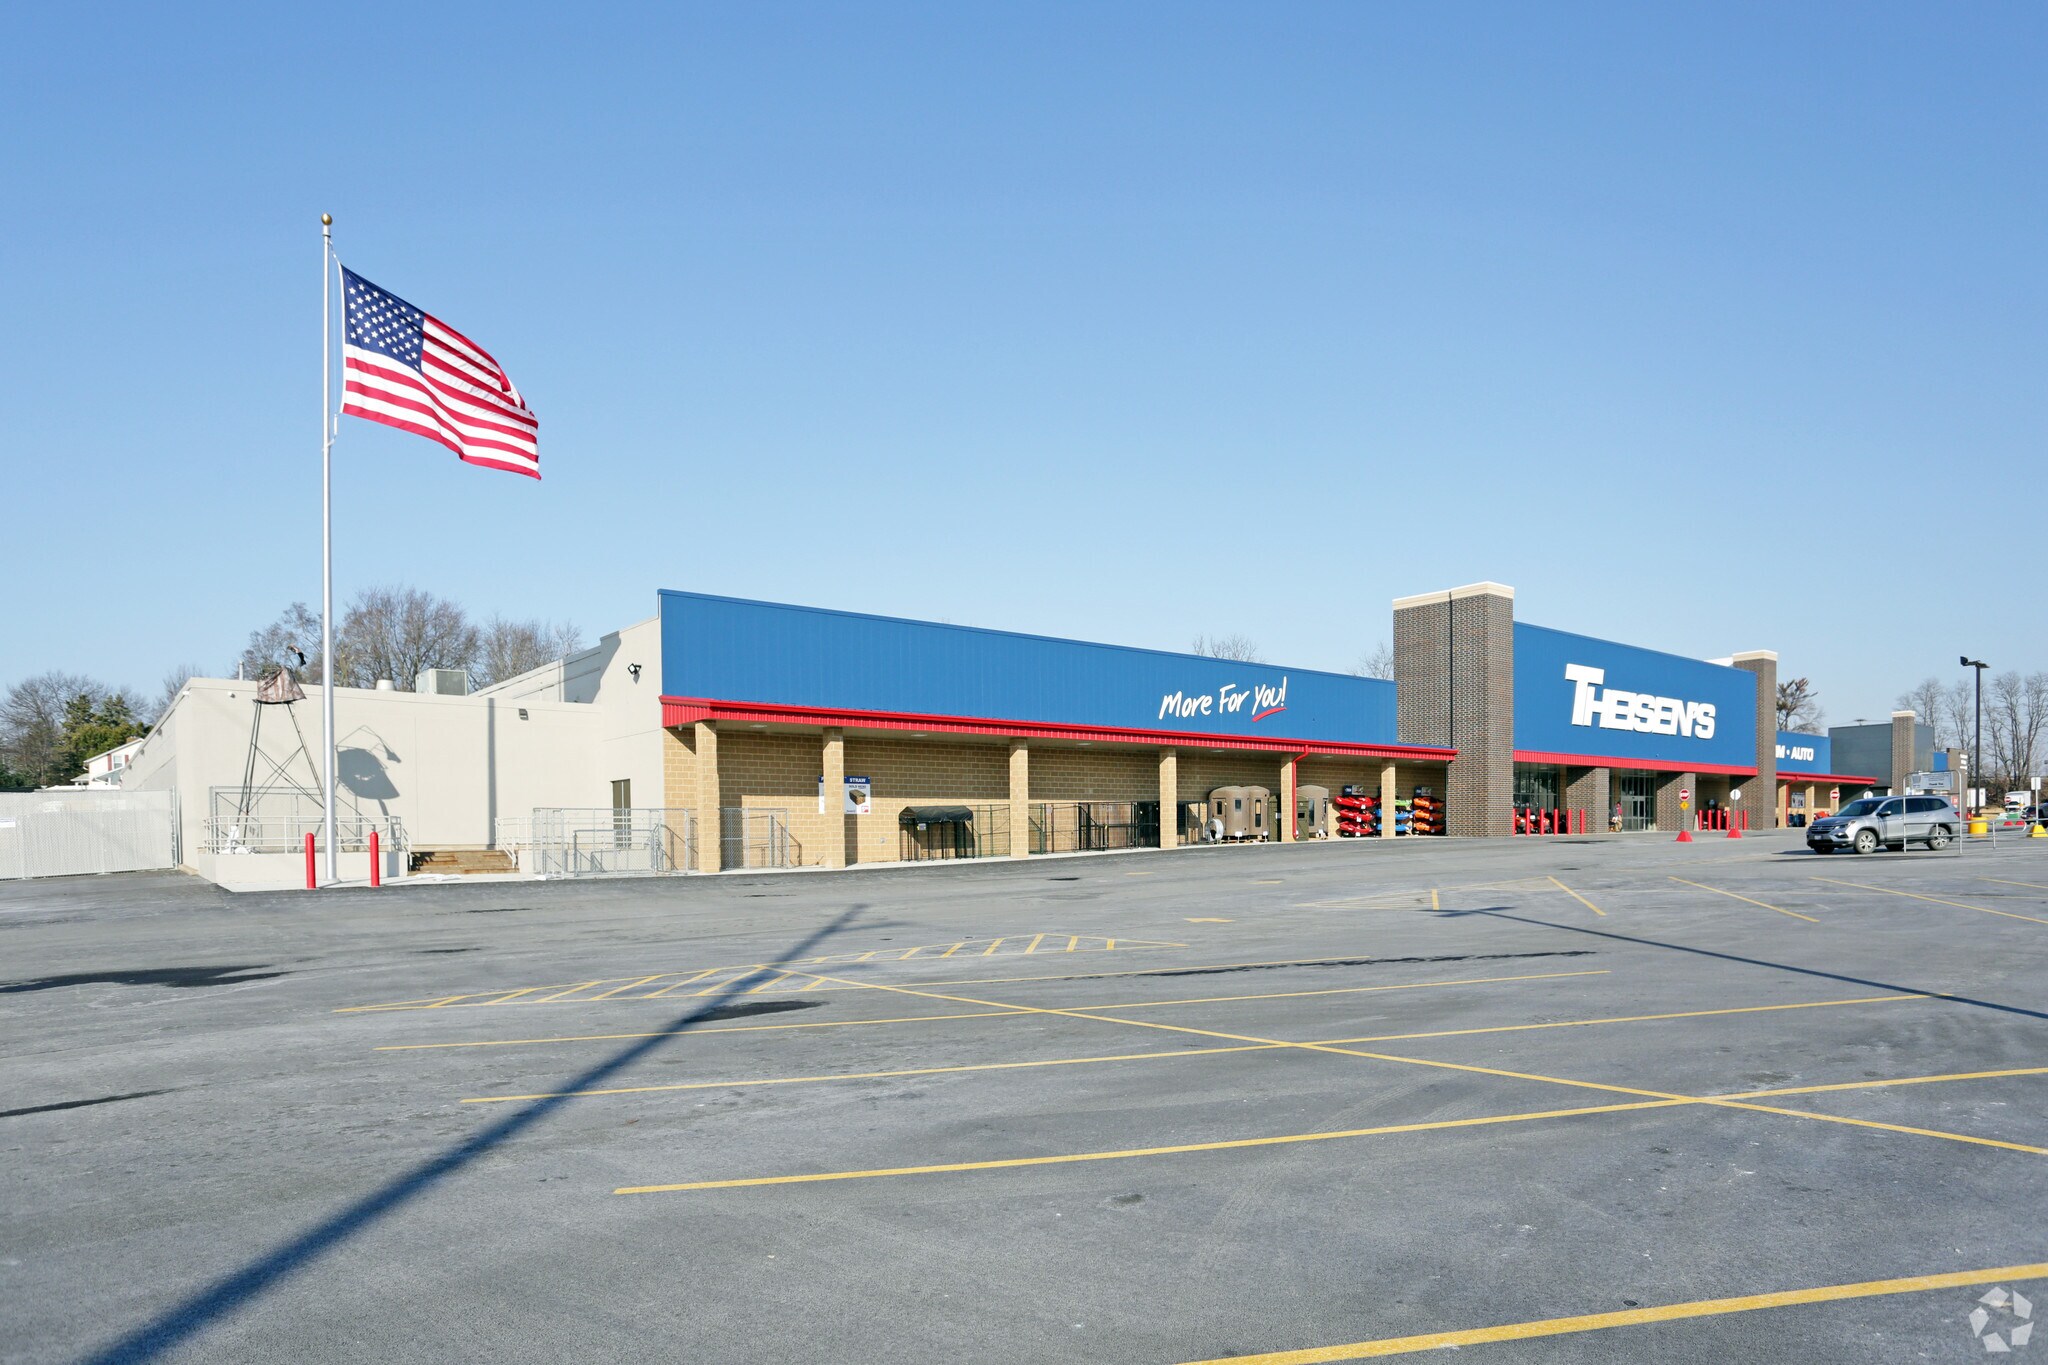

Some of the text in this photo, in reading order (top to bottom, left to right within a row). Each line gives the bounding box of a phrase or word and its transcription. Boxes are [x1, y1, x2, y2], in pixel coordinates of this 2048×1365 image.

[1159, 676, 1287, 720] More For You!
[1775, 744, 1814, 761] M AUTO
